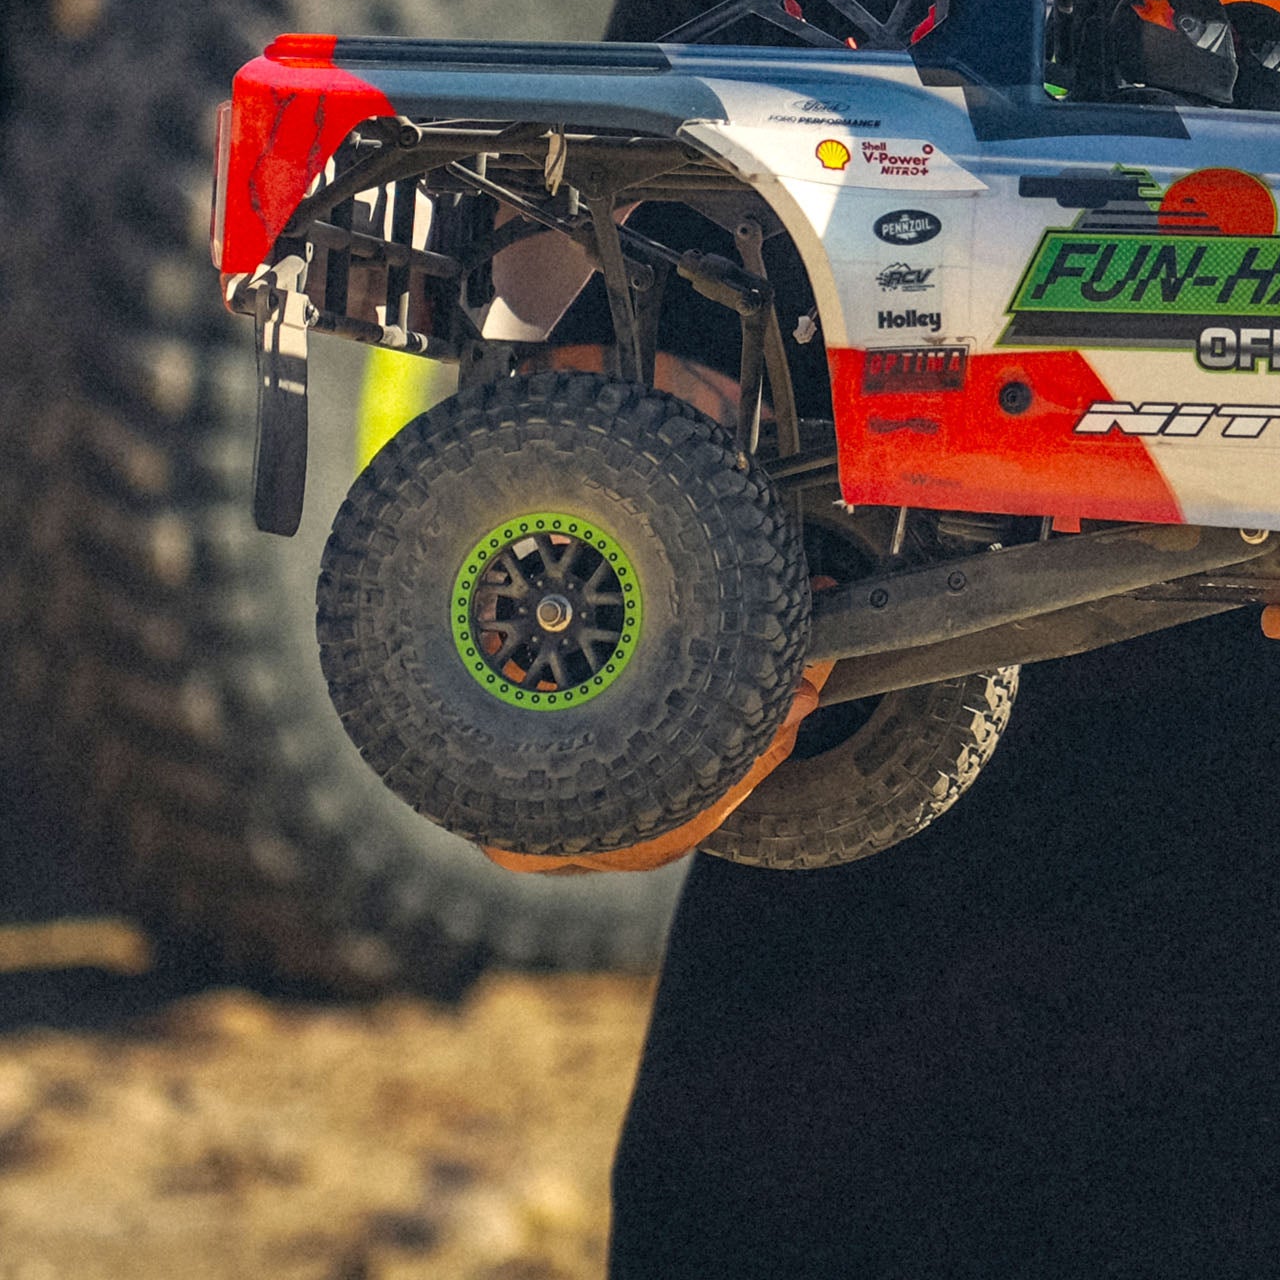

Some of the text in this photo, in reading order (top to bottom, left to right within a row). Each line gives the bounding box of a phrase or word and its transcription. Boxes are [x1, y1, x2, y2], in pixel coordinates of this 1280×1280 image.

[797, 116, 881, 128] PERFORMANCE
[862, 141, 887, 152] Shell
[862, 152, 930, 166] V-Power
[882, 218, 931, 236] PENNZOIL
[878, 310, 941, 332] Holley
[870, 351, 960, 375] OPTIMA
